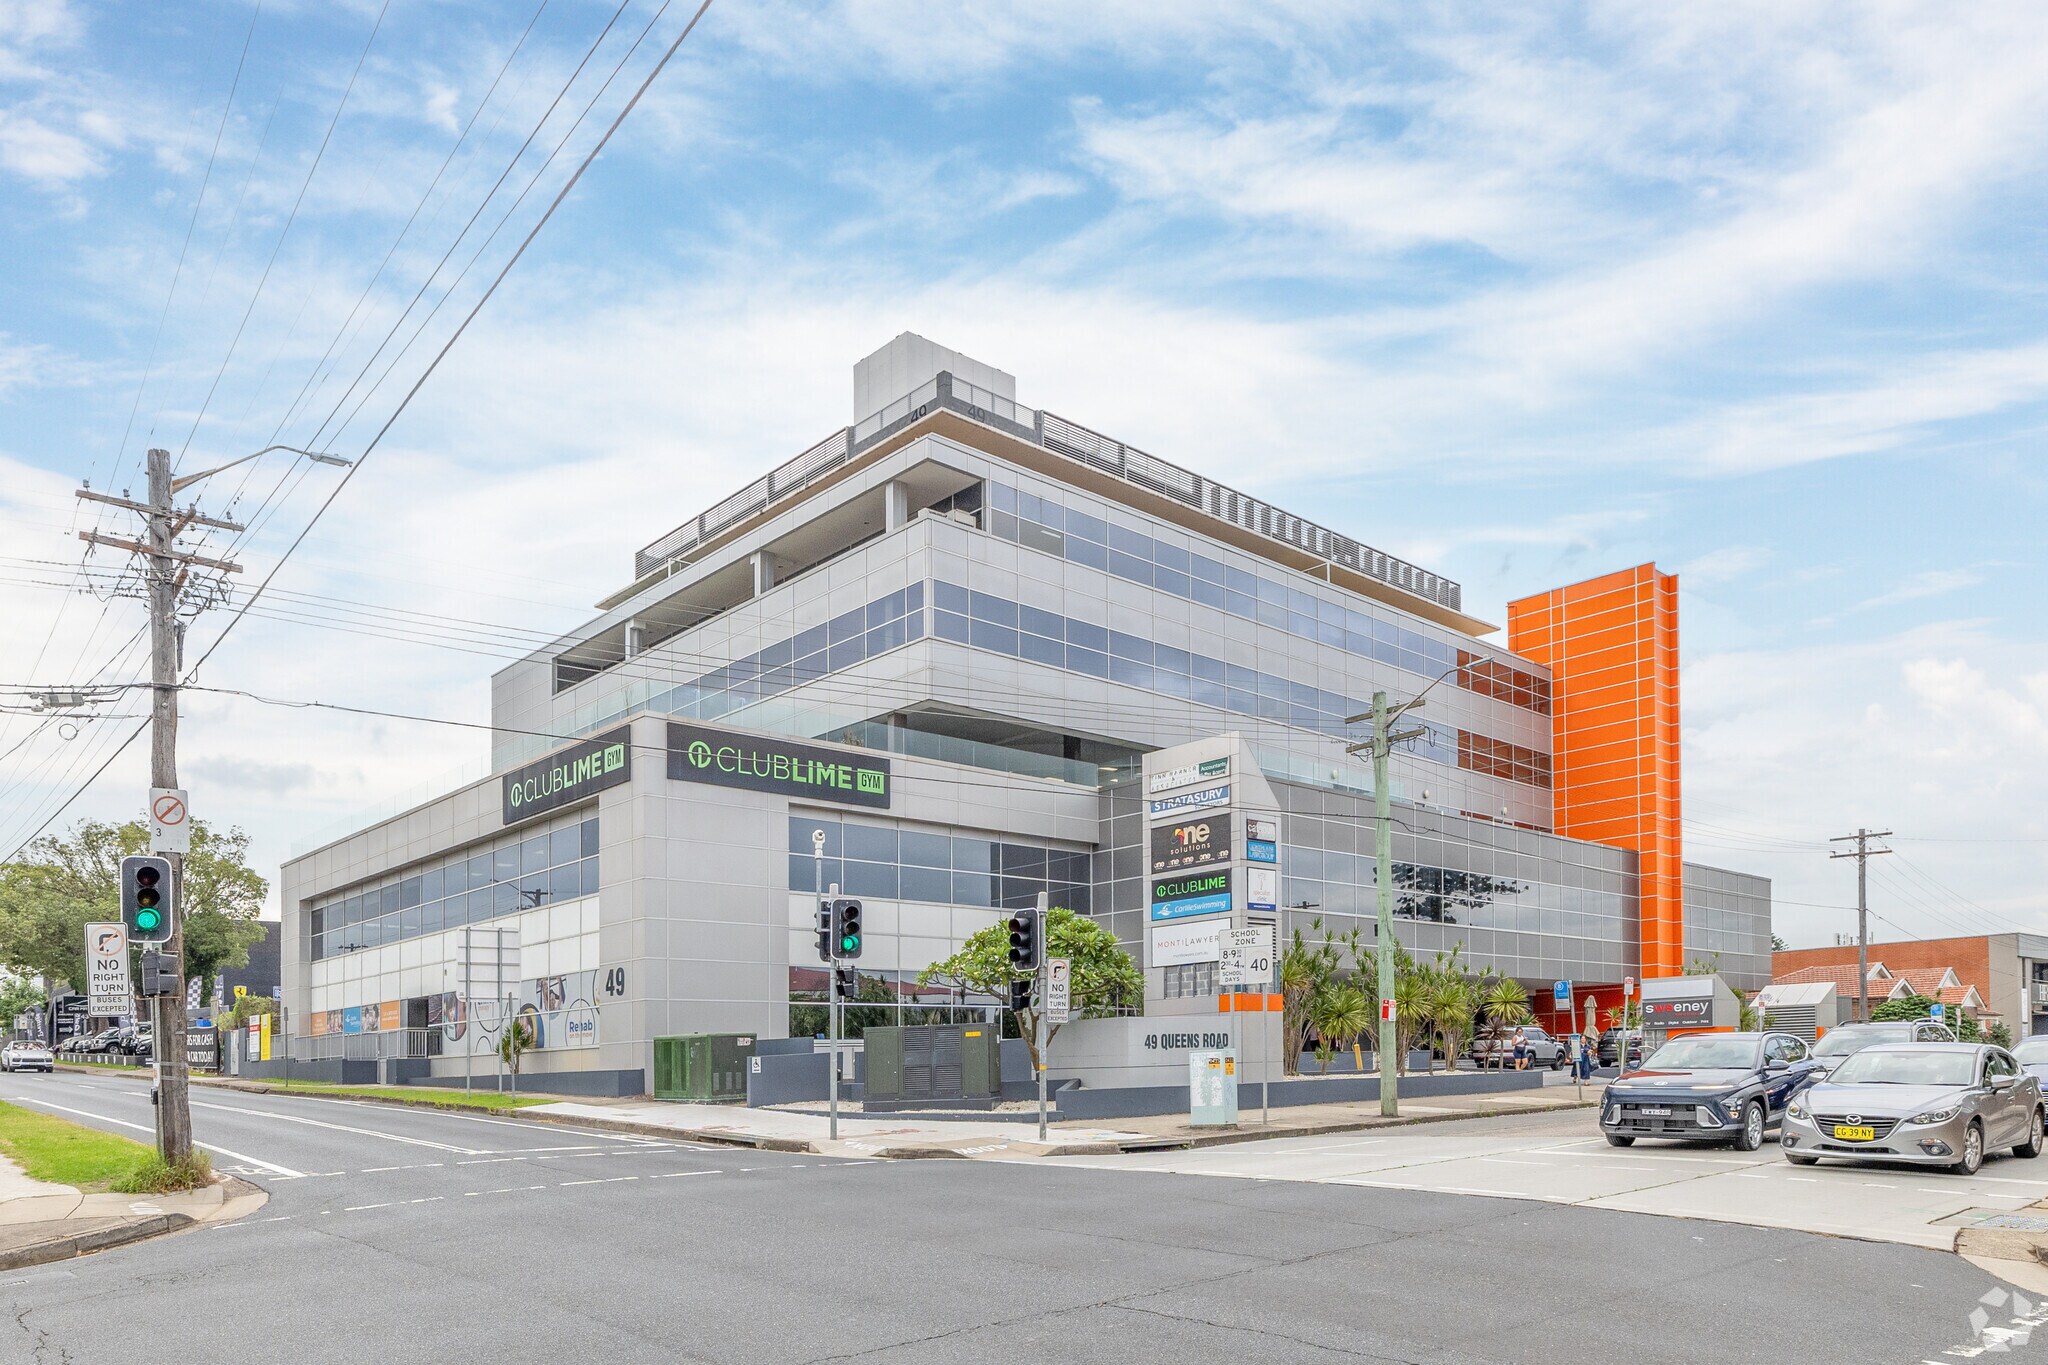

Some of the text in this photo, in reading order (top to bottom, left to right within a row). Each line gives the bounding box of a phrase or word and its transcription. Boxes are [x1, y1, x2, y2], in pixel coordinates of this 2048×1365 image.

[911, 404, 927, 422] 49
[967, 405, 985, 423] 49
[607, 748, 622, 767] GYM
[861, 773, 881, 790] GYM
[1154, 787, 1223, 811] STRATASURV
[155, 827, 162, 837] 3
[1170, 842, 1211, 855] solutions
[1230, 929, 1261, 938] SCHOOL
[1235, 938, 1256, 946] ZONE
[97, 959, 119, 971] NO
[1250, 957, 1268, 972] 40
[93, 973, 125, 982] RIGHT
[605, 967, 625, 997] 49
[94, 983, 124, 992] TURN
[1051, 984, 1065, 992] NO
[92, 1005, 128, 1013] EXCEPTED
[1645, 1001, 1709, 1015] sweeney
[201, 1033, 214, 1046] CASH
[1144, 1032, 1229, 1050] 49 QUEENS ROAD
[1836, 1127, 1872, 1137] CG 39 NY
